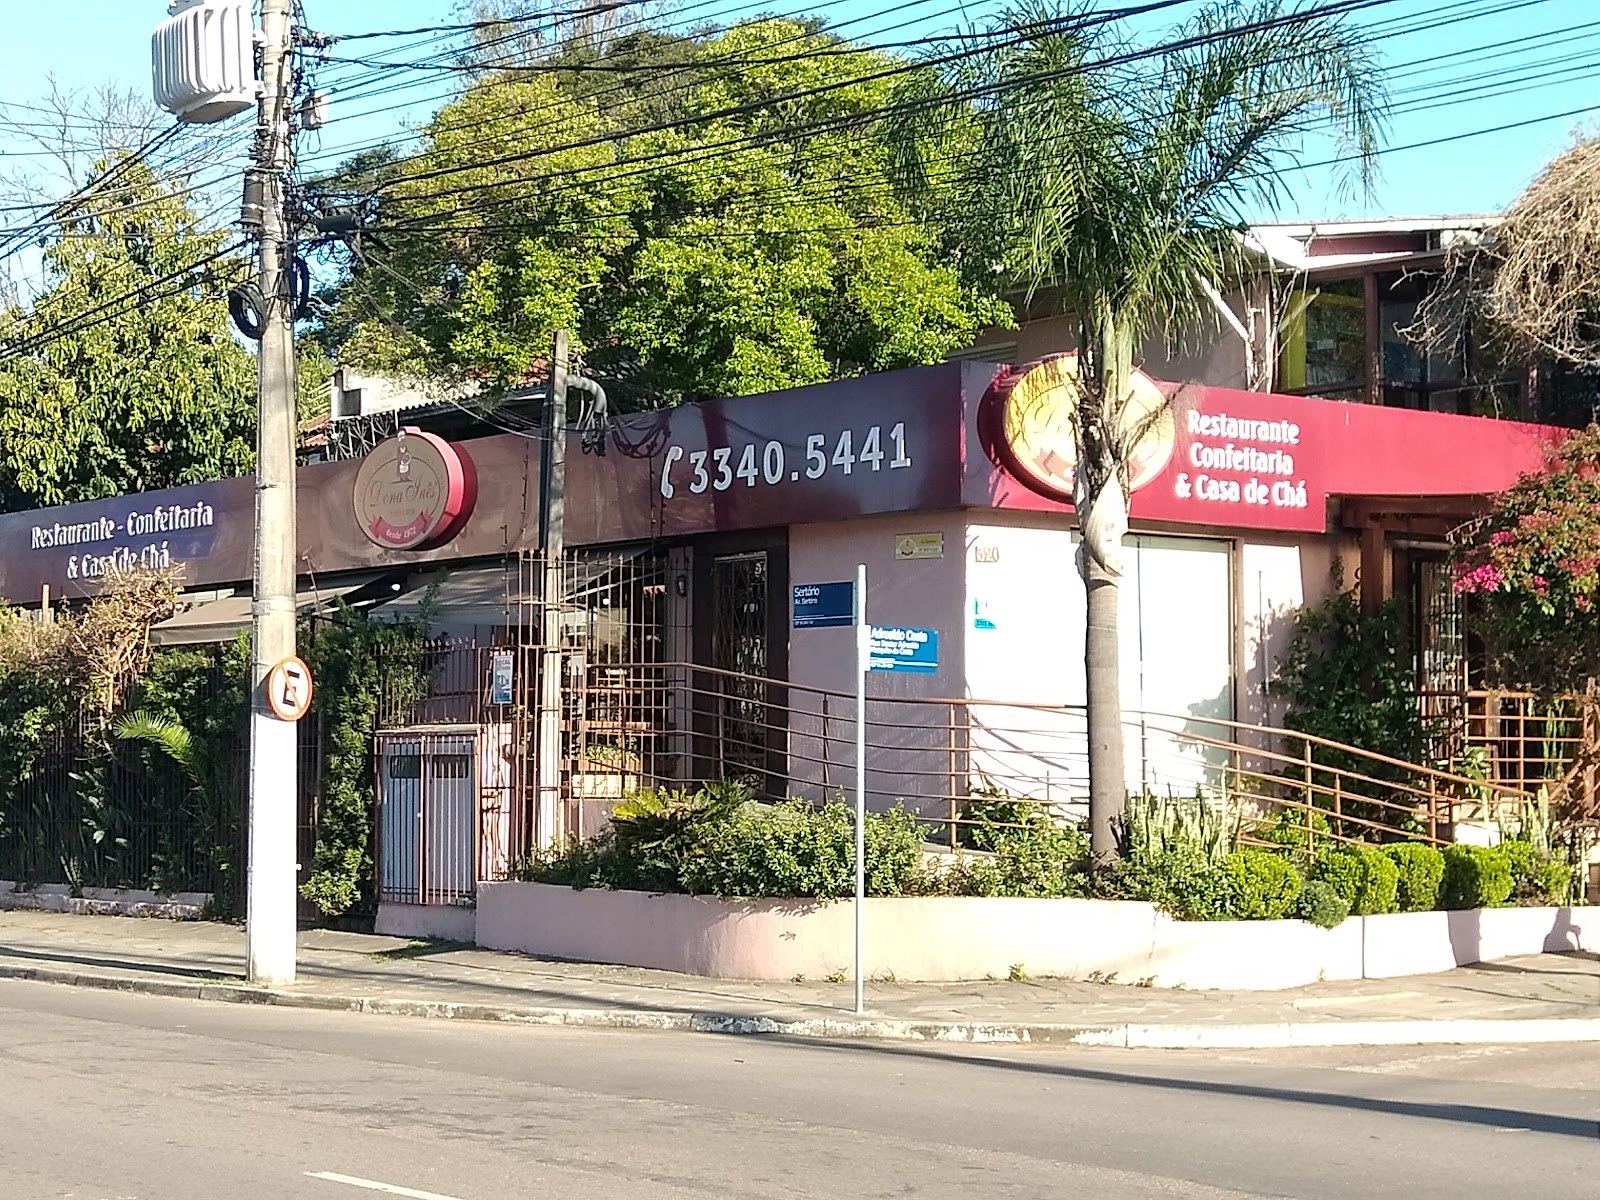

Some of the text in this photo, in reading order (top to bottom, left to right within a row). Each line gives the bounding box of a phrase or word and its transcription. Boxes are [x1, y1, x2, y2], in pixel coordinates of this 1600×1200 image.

[1188, 409, 1300, 445] Restaurante
[689, 422, 911, 494] 3340.5441
[1190, 442, 1294, 475] Confeitaria
[1175, 472, 1308, 508] & Casa de Chá
[31, 516, 116, 549] Restaurante
[127, 501, 213, 536] Confeitaria
[67, 555, 79, 580] &
[118, 546, 138, 574] de
[141, 540, 170, 570] Chá
[794, 585, 820, 597] Sertório
